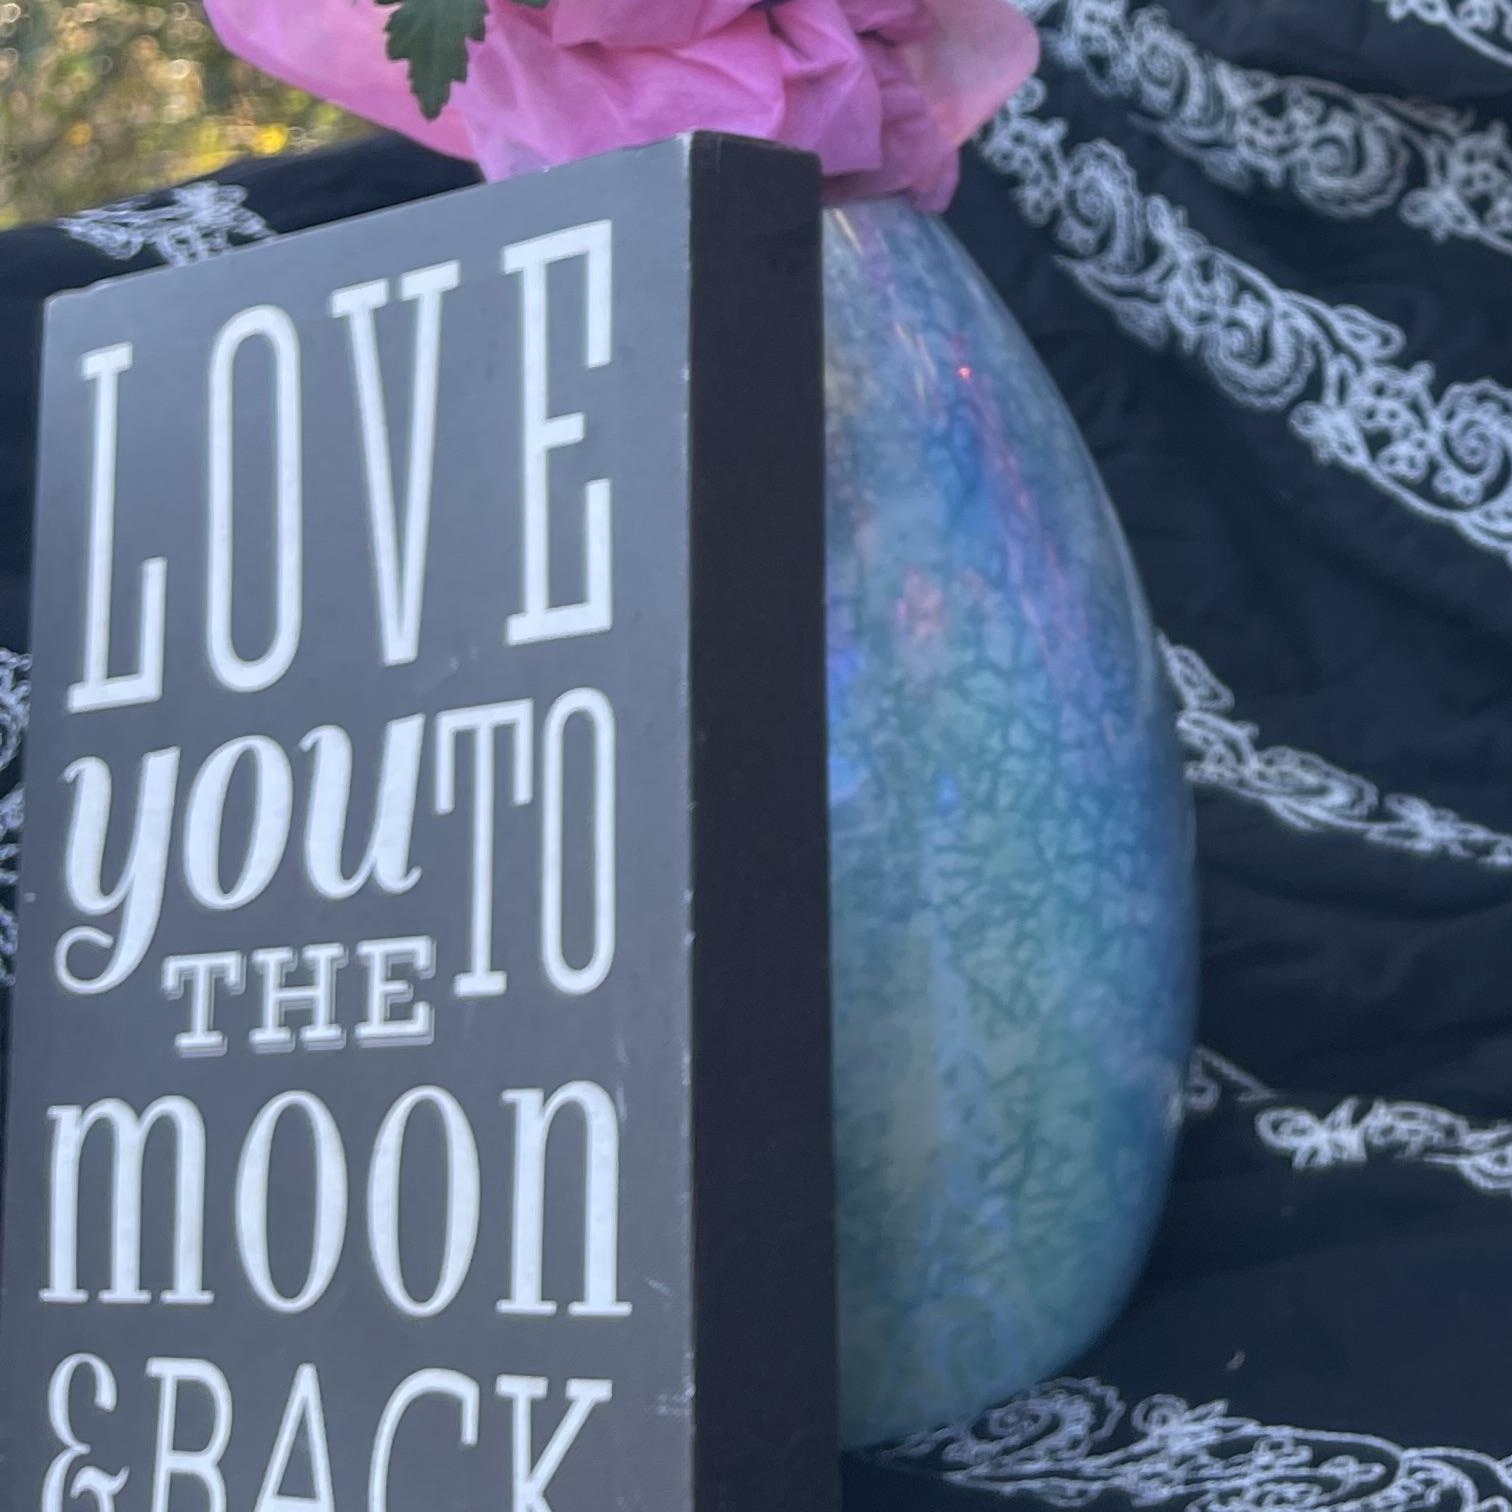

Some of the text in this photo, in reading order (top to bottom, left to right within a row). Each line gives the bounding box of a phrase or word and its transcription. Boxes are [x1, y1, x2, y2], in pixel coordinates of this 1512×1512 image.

[66, 218, 613, 715] LOVE
[54, 686, 617, 998] you TO
[160, 933, 438, 1059] THE
[38, 1079, 633, 1319] moon
